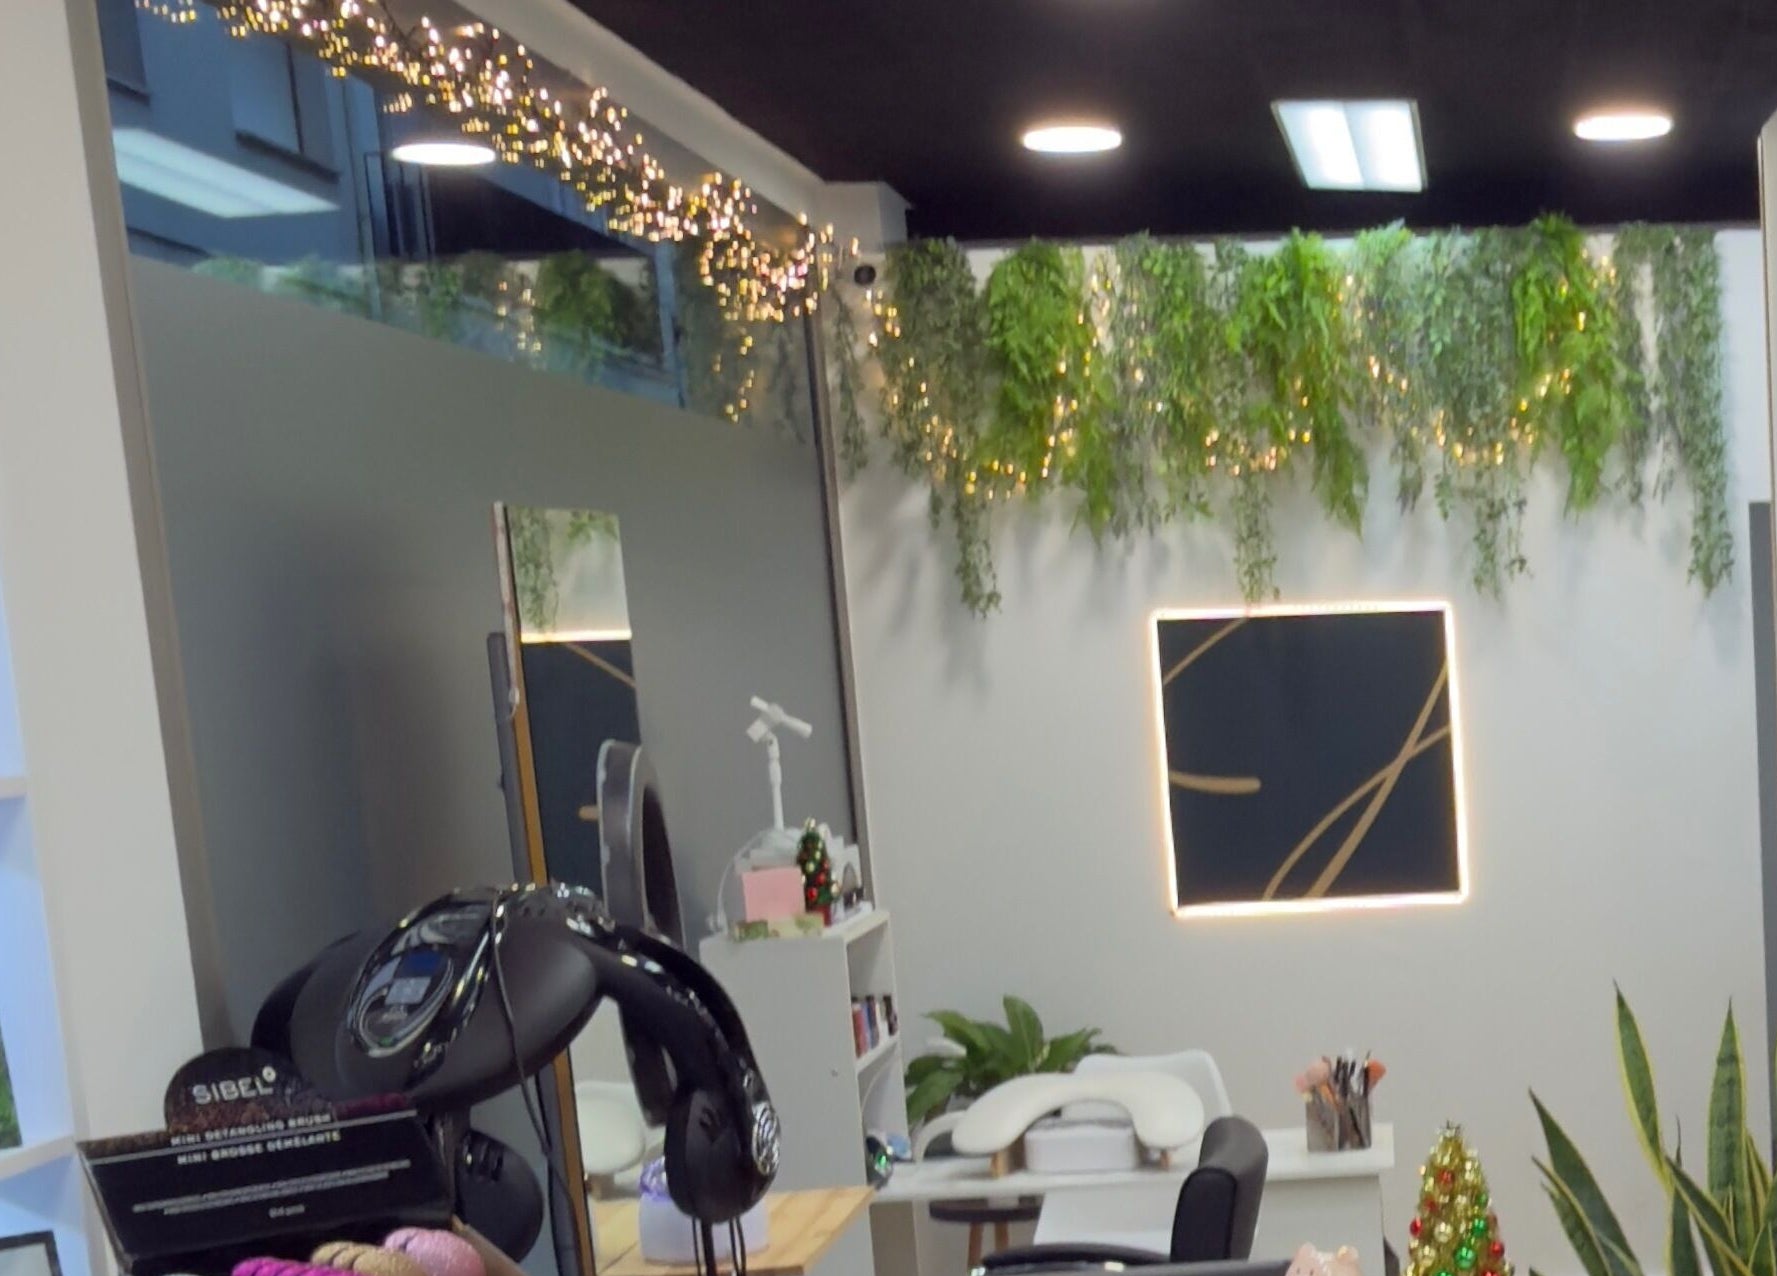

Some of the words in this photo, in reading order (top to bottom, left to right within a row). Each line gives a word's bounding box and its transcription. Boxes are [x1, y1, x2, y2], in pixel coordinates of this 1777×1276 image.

[192, 1077, 274, 1105] SIBEL
[170, 1132, 201, 1147] MINI
[204, 1118, 286, 1142] DETANGLING
[287, 1112, 332, 1130] BRUSH
[177, 1150, 208, 1166] MINI
